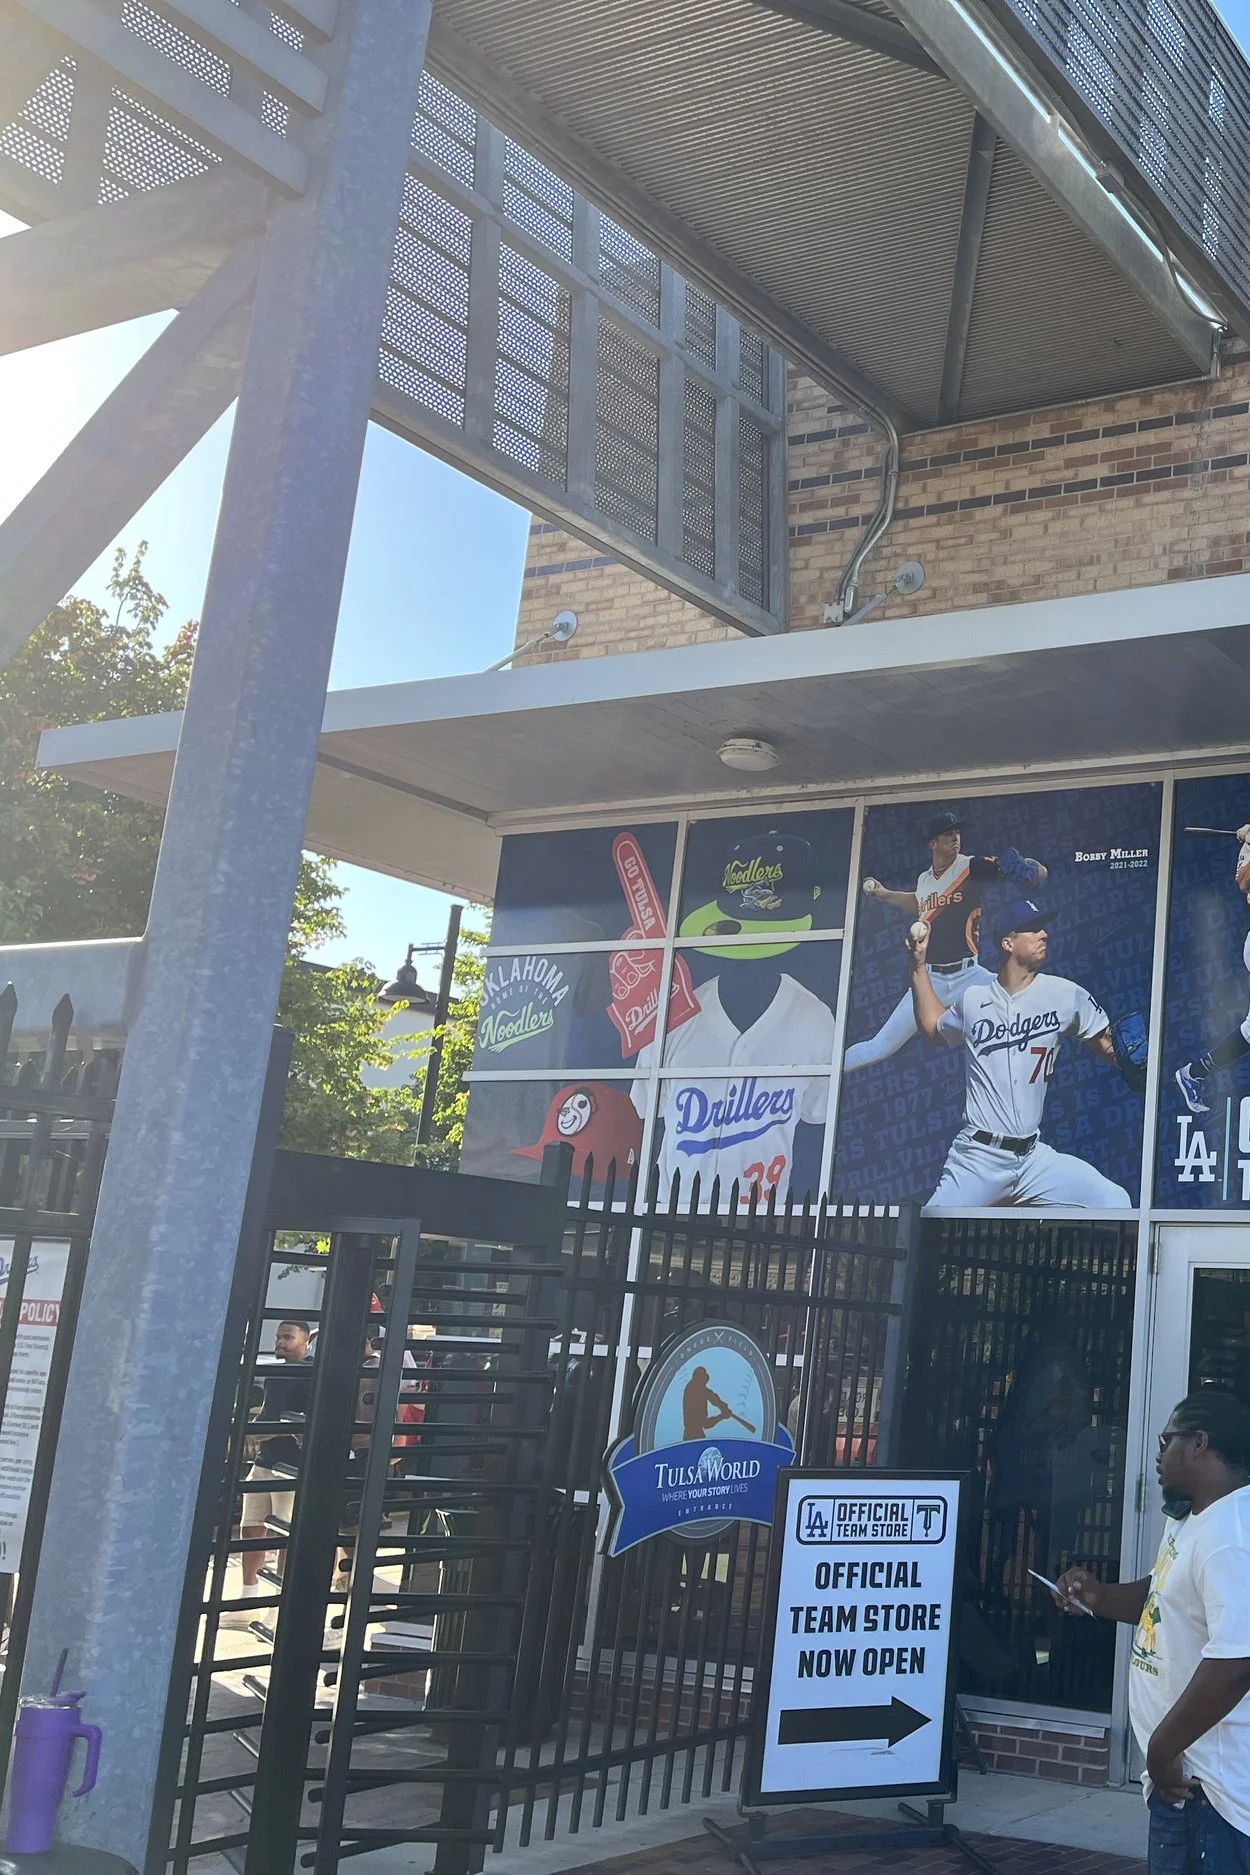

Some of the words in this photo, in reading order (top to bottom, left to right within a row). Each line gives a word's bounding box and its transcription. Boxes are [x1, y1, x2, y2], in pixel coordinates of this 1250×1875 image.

[623, 856, 640, 879] GO
[722, 856, 784, 894] Noodlers
[1110, 859, 1148, 870] 2021-2022
[631, 878, 659, 932] TULSA
[518, 984, 530, 995] OF
[533, 988, 549, 1006] THE
[478, 1002, 554, 1054] Noodlers
[972, 1010, 1061, 1058] Dodgers
[675, 1076, 796, 1157] Drillers
[1174, 1115, 1218, 1182] LA
[740, 1154, 787, 1205] 39
[662, 1489, 687, 1502] WHERE
[687, 1487, 708, 1499] YOUR
[707, 1485, 730, 1497] STORY
[730, 1483, 748, 1494] LIVES
[837, 1503, 909, 1523] OFFICIAL
[836, 1523, 870, 1539] TEAM
[871, 1522, 909, 1538] STORE
[814, 1561, 922, 1590] OFFICIAL
[790, 1606, 857, 1635] TEAM
[863, 1603, 942, 1631] STORE
[797, 1648, 857, 1678] NOW
[861, 1646, 926, 1676] OPEN
